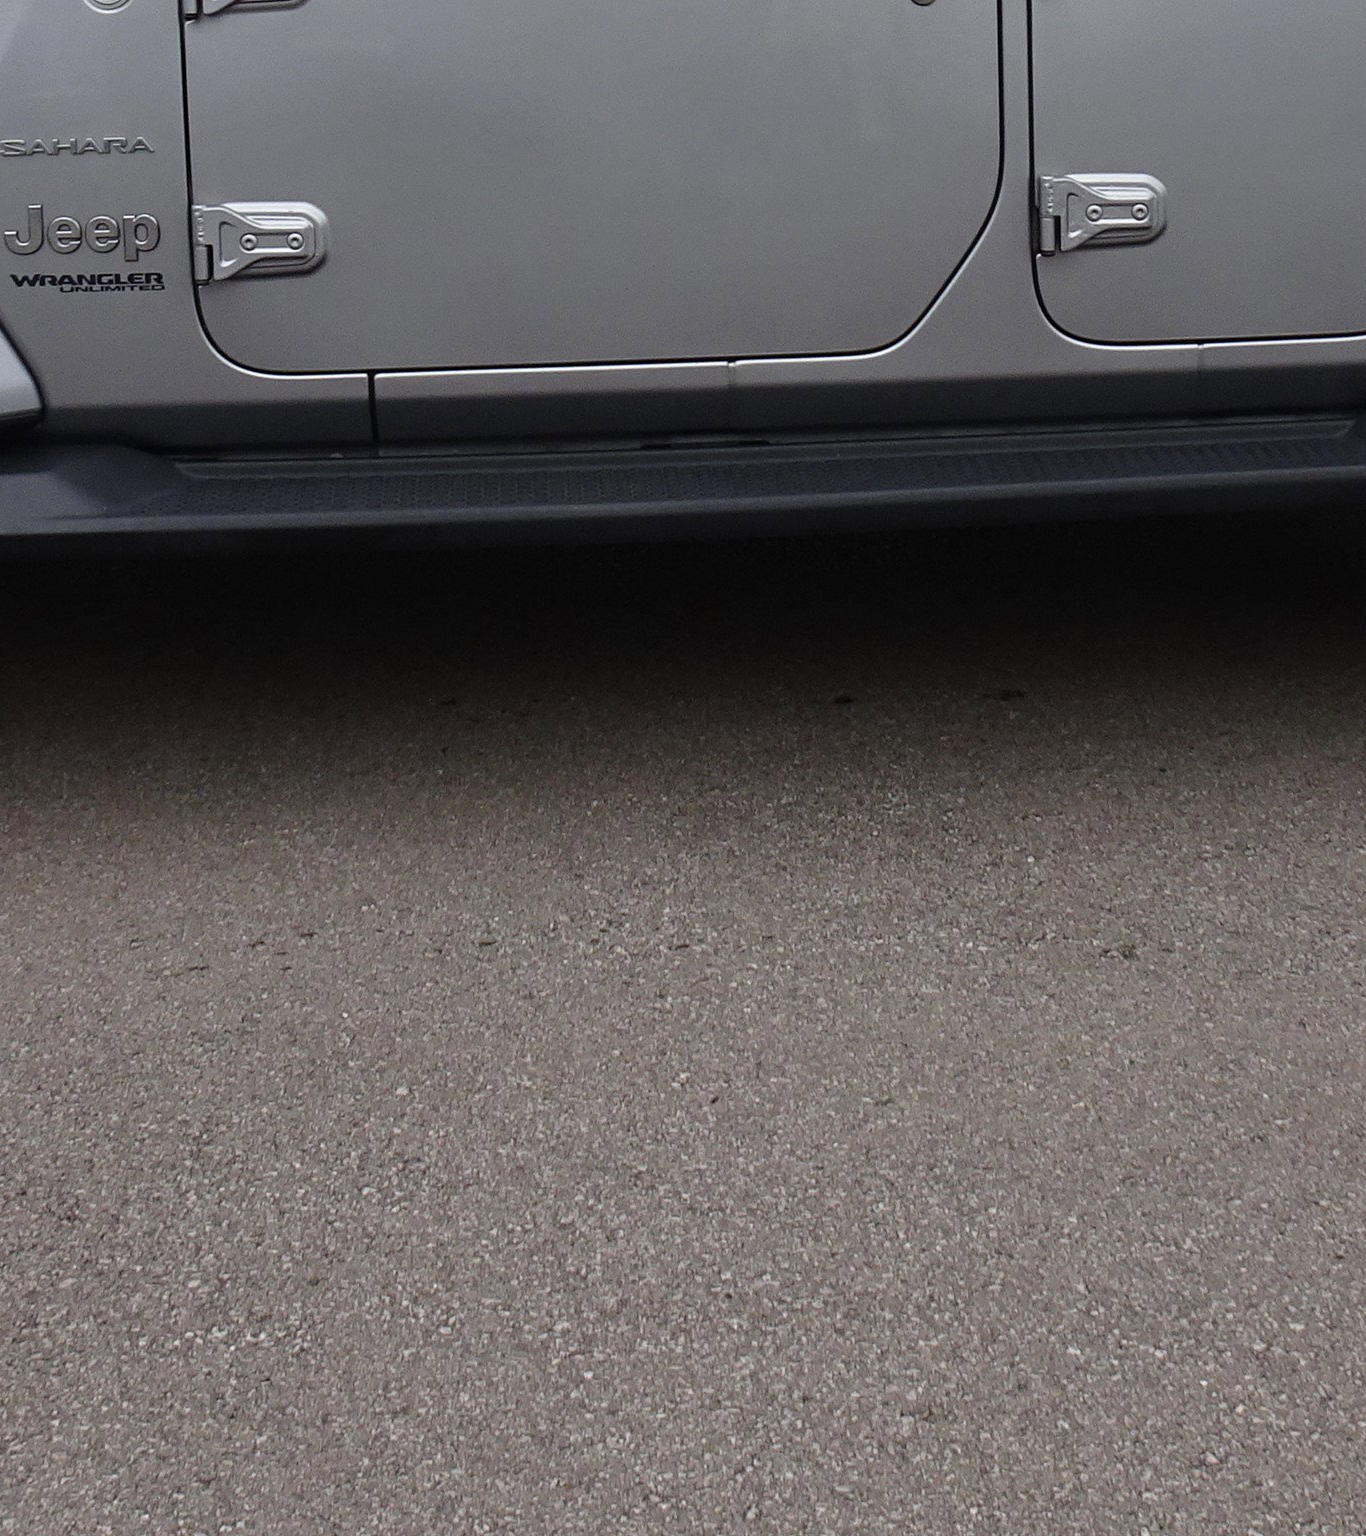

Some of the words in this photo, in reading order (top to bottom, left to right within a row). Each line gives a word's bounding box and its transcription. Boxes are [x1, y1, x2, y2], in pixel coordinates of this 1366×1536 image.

[3, 203, 162, 263] Jeep
[9, 271, 165, 288] WRANGLER
[58, 283, 166, 294] UNLIMITED
